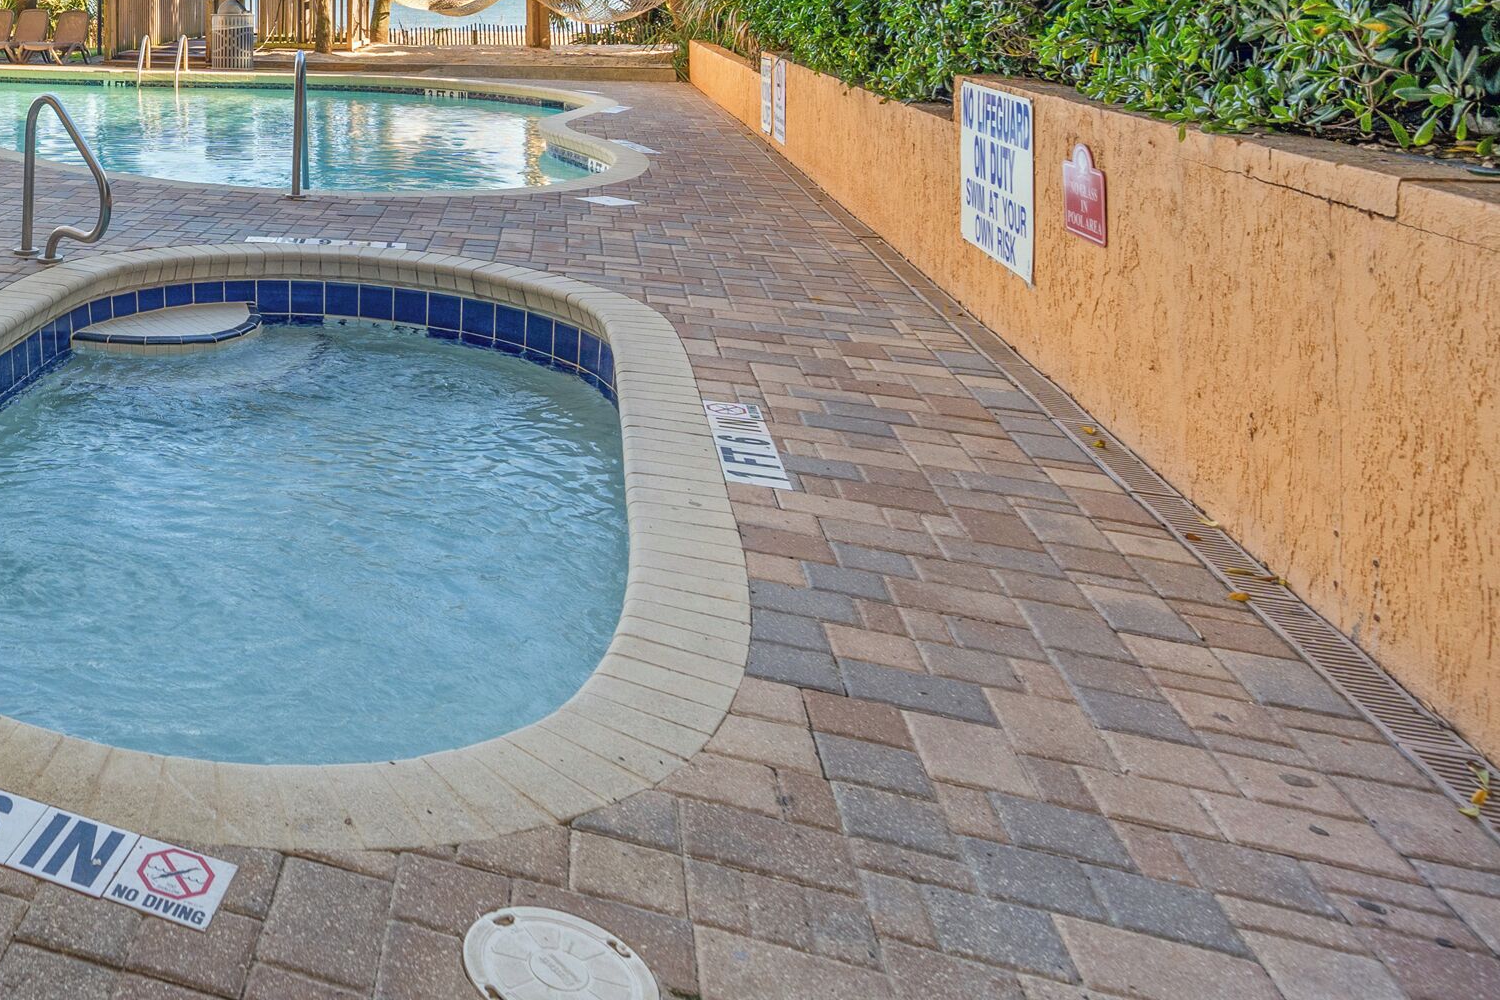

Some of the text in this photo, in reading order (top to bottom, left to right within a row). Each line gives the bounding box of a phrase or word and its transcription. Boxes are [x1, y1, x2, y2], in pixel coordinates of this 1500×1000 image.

[963, 86, 1030, 150] NO LIFEGUARD
[974, 134, 1015, 194] ON DUTY
[966, 178, 1027, 239] SWIM AT YOUR
[1067, 209, 1102, 235] POOL AREA
[1080, 199, 1088, 213] IN
[975, 213, 1017, 267] OWN RISK
[715, 416, 791, 481] 1 FT 6 IN
[18, 812, 127, 889] IN
[111, 883, 139, 904] NO
[141, 893, 206, 925] DIVING
